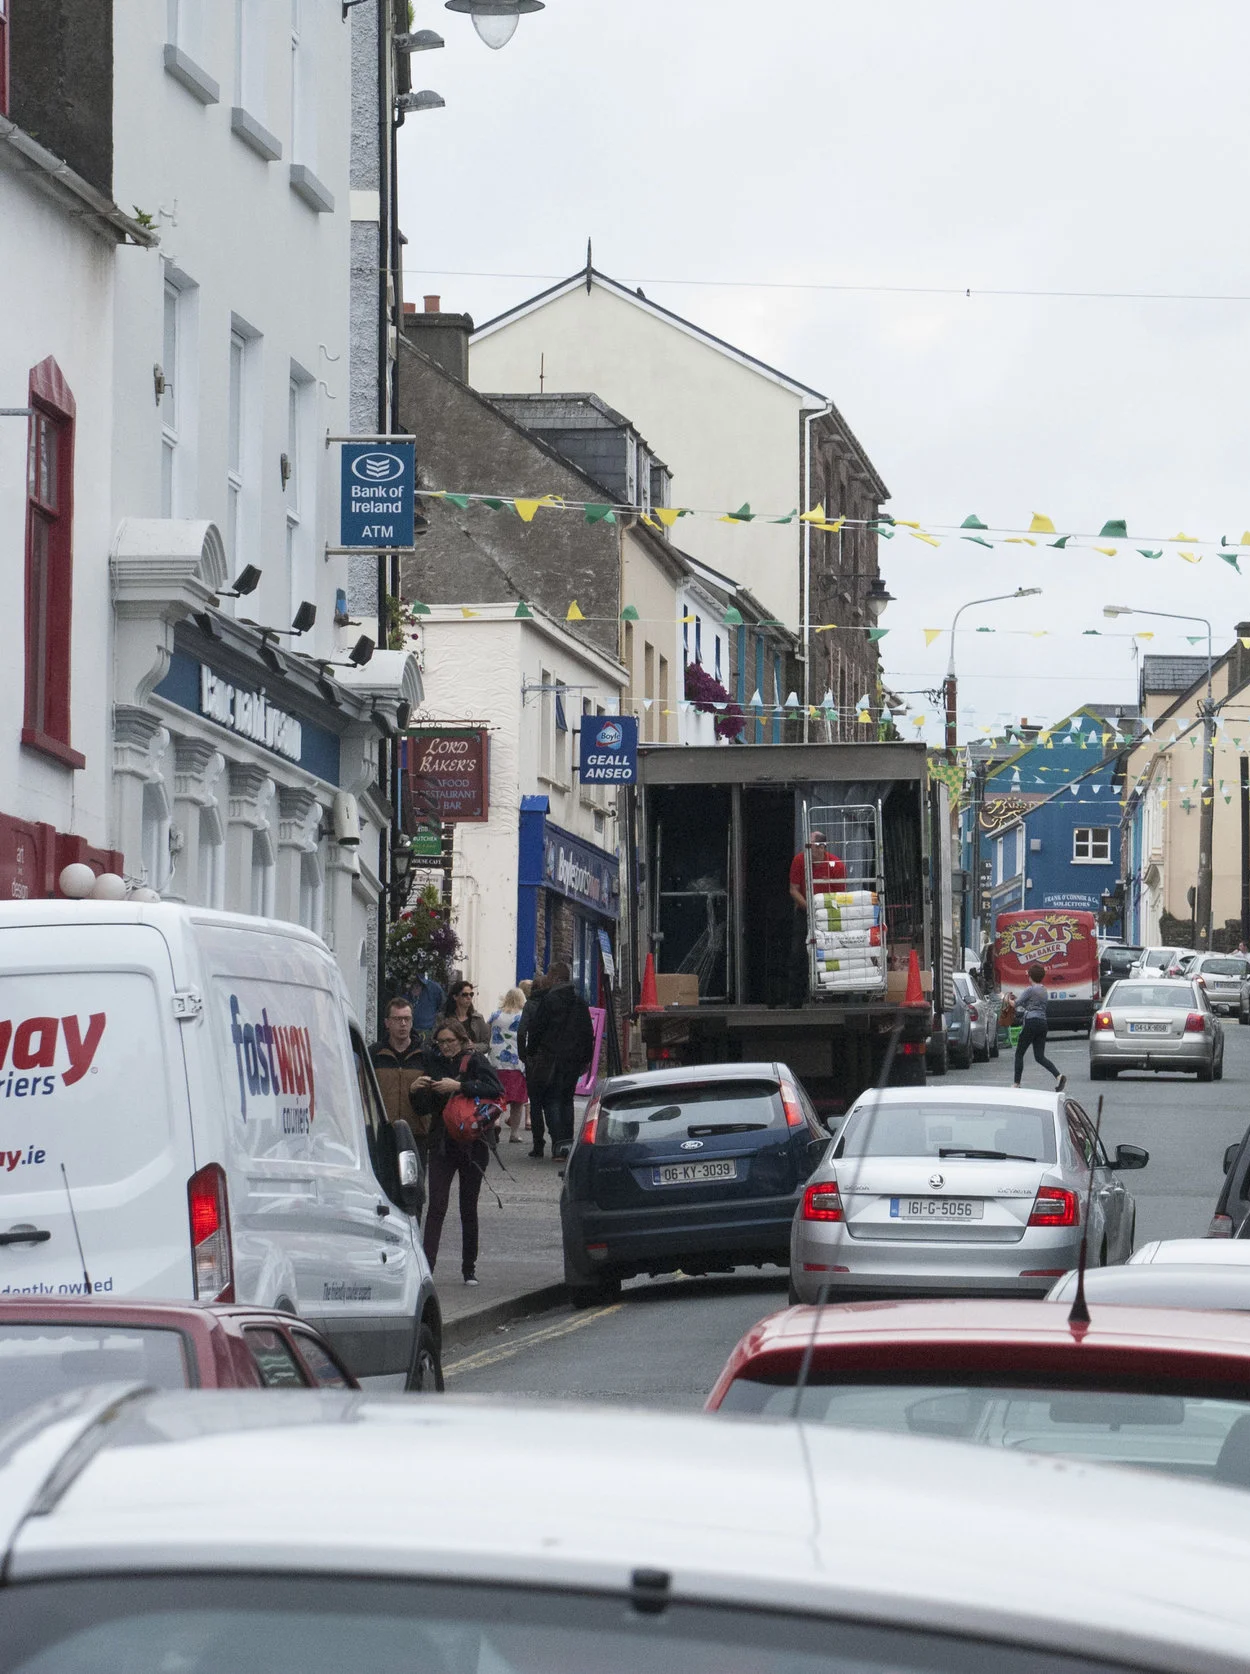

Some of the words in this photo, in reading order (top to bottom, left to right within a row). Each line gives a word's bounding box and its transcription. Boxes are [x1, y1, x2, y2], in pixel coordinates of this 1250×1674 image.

[351, 486, 387, 498] Bank
[389, 486, 404, 498] of
[351, 501, 402, 513] Ireland
[361, 525, 394, 538] ATM
[587, 754, 630, 766] GEALL
[585, 768, 633, 779] ANSEO
[421, 790, 477, 799] ESTAURANT
[443, 801, 462, 810] BAR
[1013, 922, 1072, 949] PAT
[1025, 952, 1037, 961] The
[1037, 944, 1061, 957] BAKER
[230, 994, 315, 1124] fastway
[283, 1107, 310, 1134] couriers
[664, 1163, 731, 1181] 06-KY-3039
[908, 1200, 973, 1217] 161-G-5056
